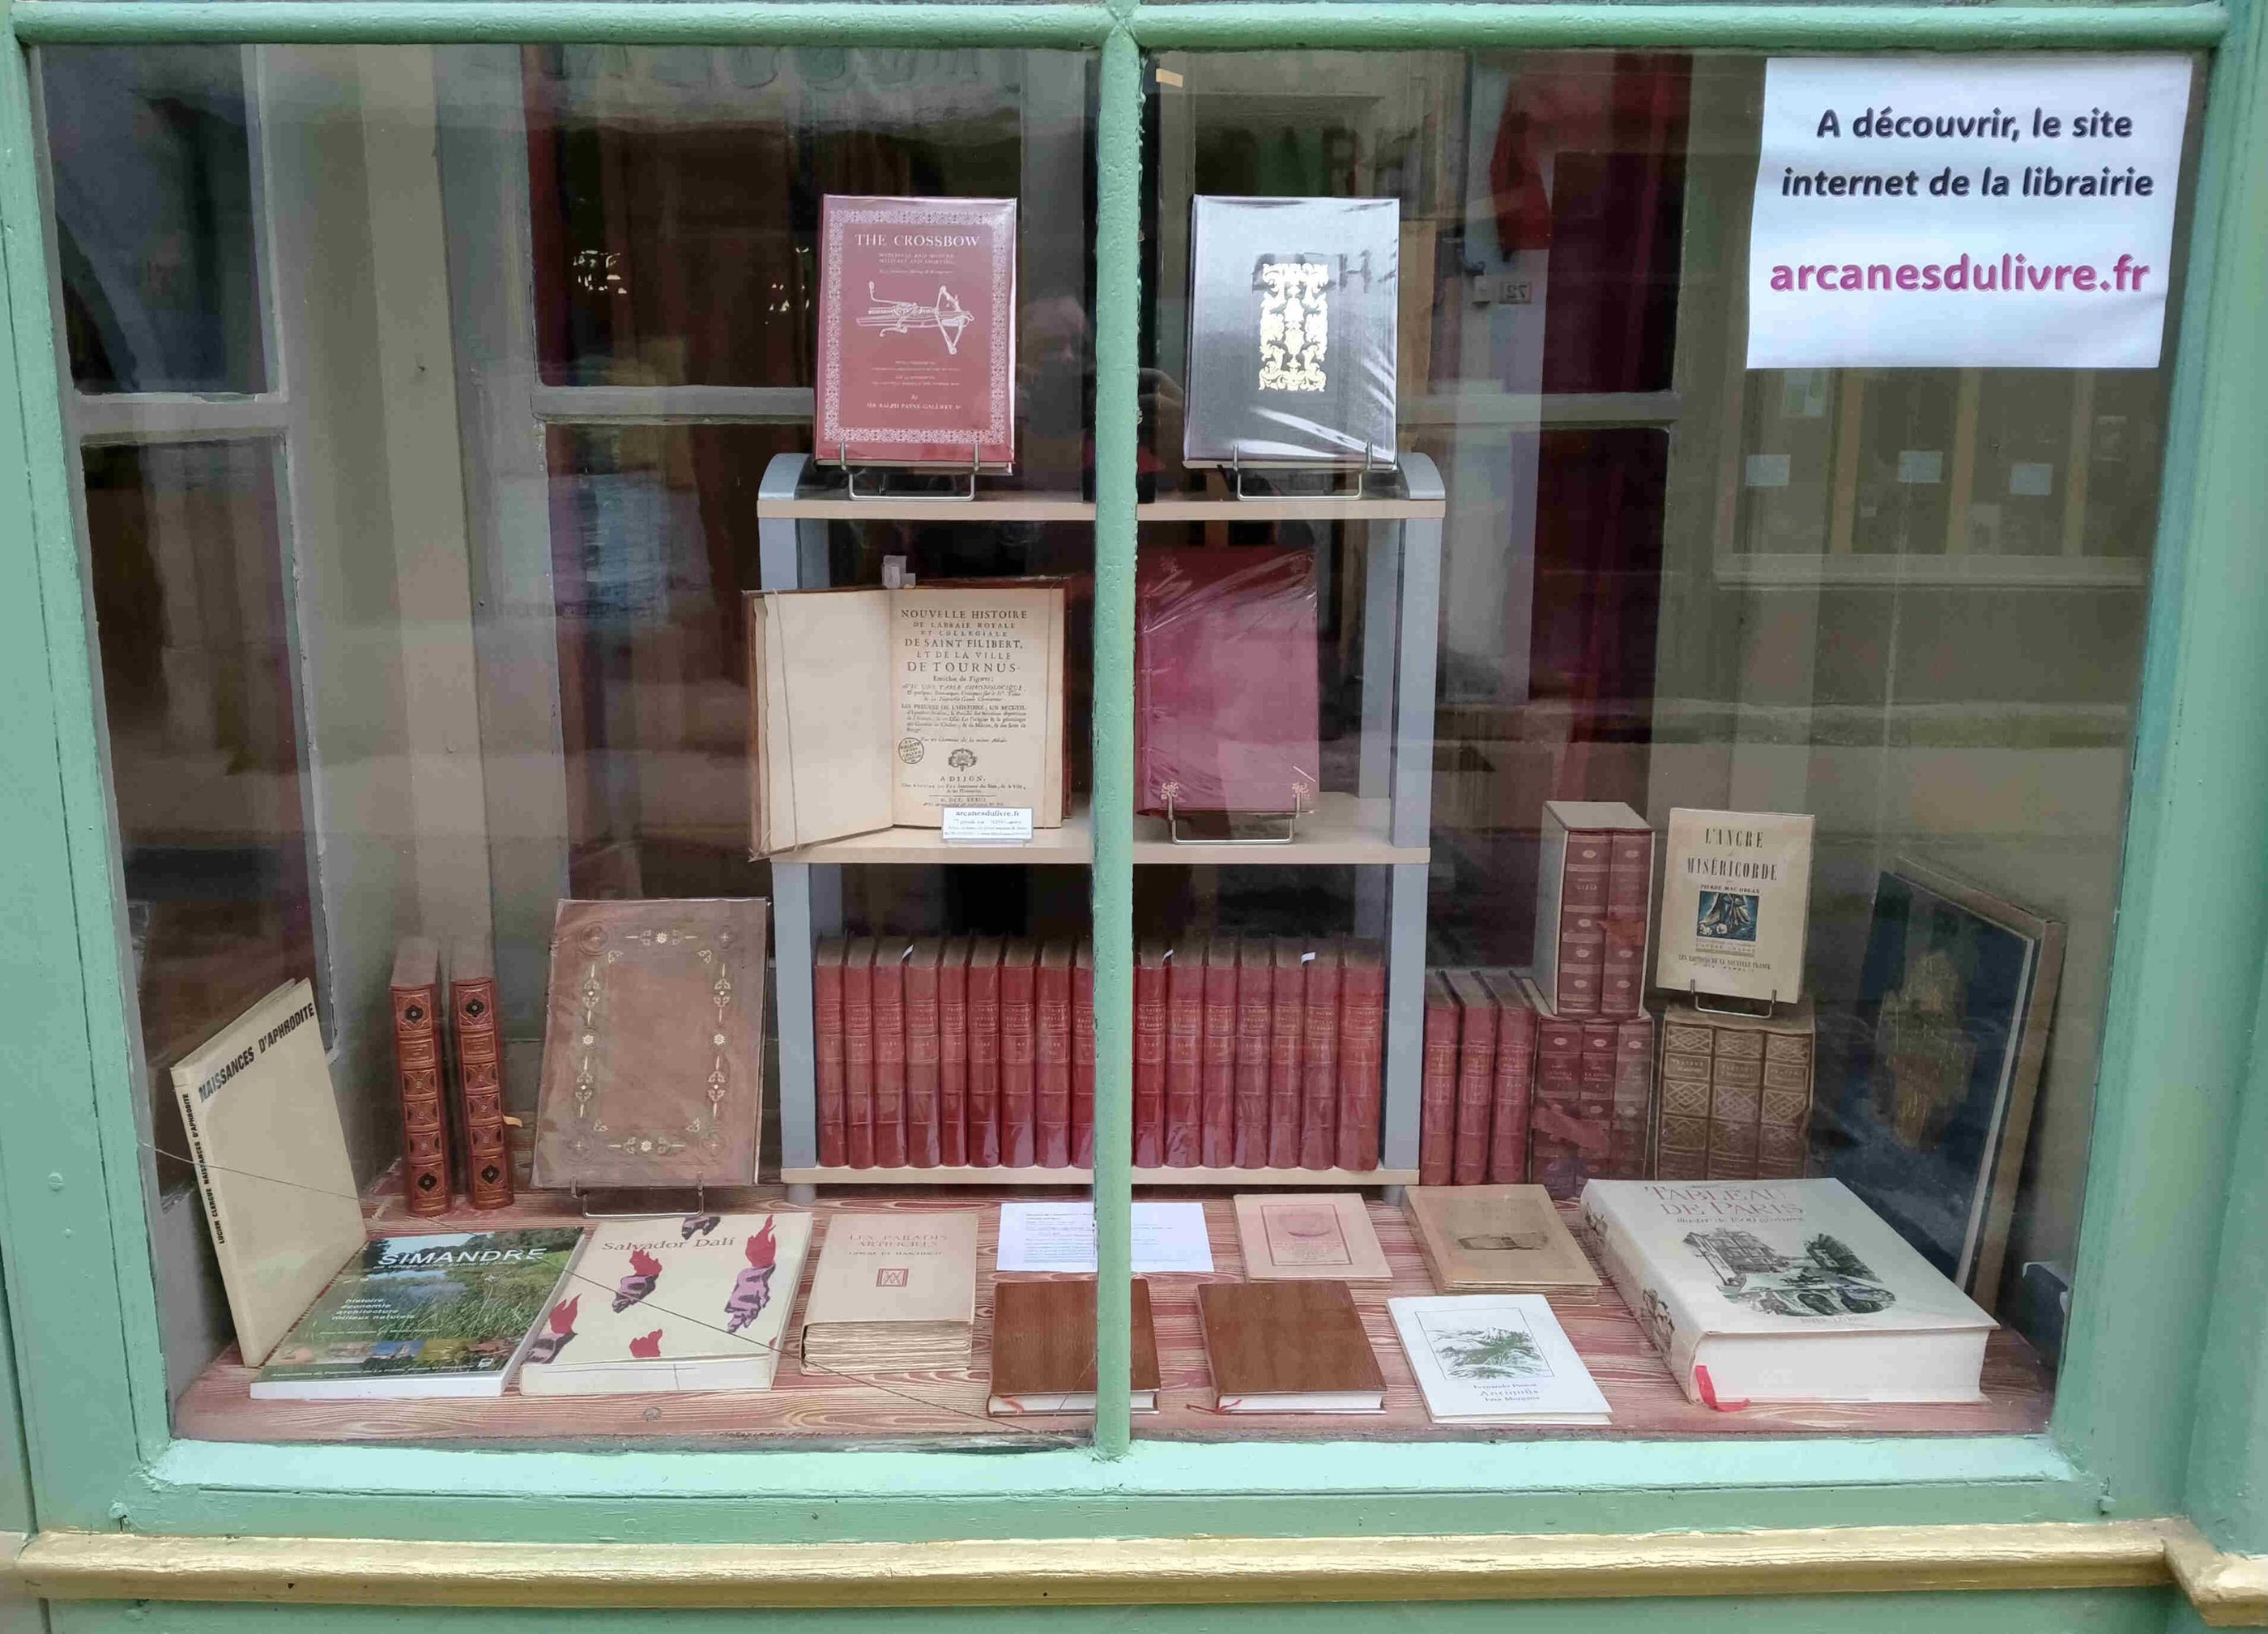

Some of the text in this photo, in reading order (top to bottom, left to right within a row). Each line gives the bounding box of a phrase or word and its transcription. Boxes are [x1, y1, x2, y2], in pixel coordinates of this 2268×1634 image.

[1817, 105, 2134, 143] A découvrir, le site
[1781, 167, 2155, 197] internet de la librairie
[855, 234, 980, 248] THE CROSSBOW
[1770, 253, 2151, 292] arcanesdulivre.fr
[901, 609, 1028, 619] NOUVELLE HISTOIRE
[905, 638, 1023, 649] DE SAINT FILIBERT,
[976, 651, 1012, 660] VILLE
[907, 661, 927, 672] DE
[1687, 857, 1778, 881] MISÉRICORDE
[198, 1002, 315, 1103] NAISSANCES D'APHRODITE
[1660, 1201, 1803, 1215] DE PARIS
[213, 1220, 225, 1244] LUCIEN
[601, 1240, 688, 1251] Salvador
[377, 1248, 548, 1265] SIMANDRE
